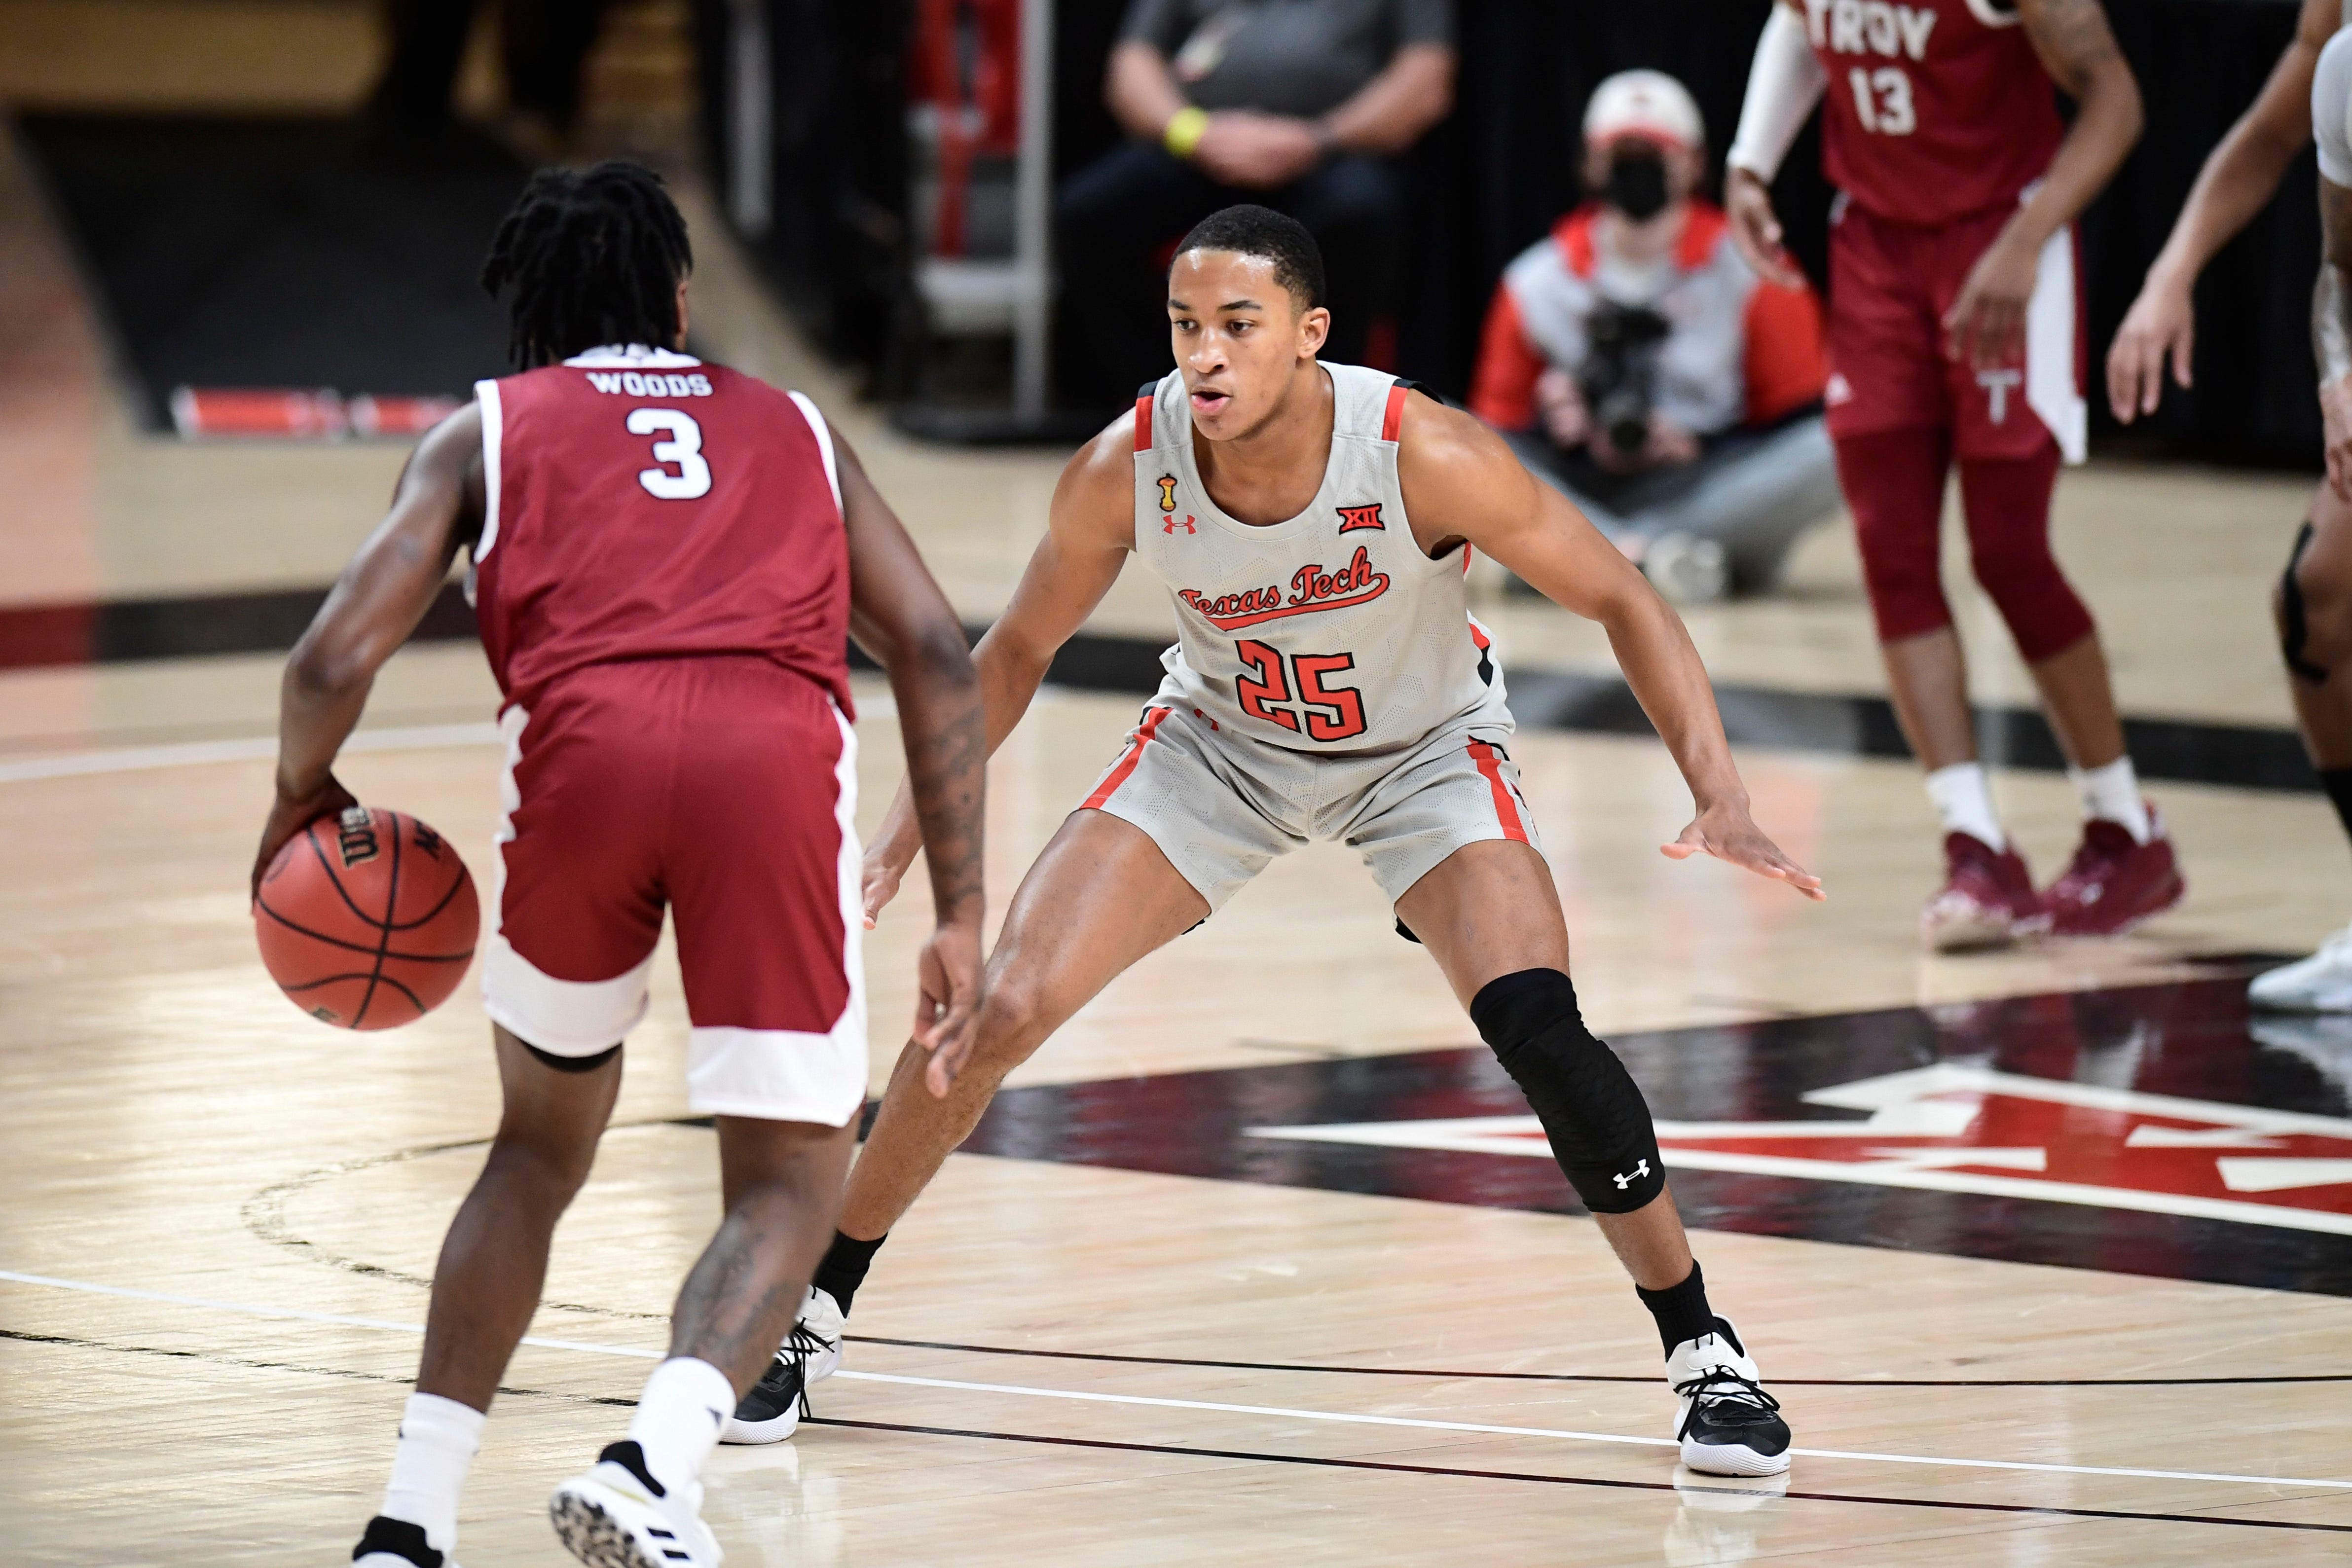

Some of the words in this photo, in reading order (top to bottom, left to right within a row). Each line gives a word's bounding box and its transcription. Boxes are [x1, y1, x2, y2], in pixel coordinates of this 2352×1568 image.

[1804, 0, 1938, 61] TROY
[1849, 67, 1916, 136] 13
[586, 371, 714, 398] WOODS
[625, 407, 712, 500] 3
[1177, 587, 1281, 617] Texas
[1288, 545, 1380, 606] Tech
[1235, 639, 1368, 742] 25
